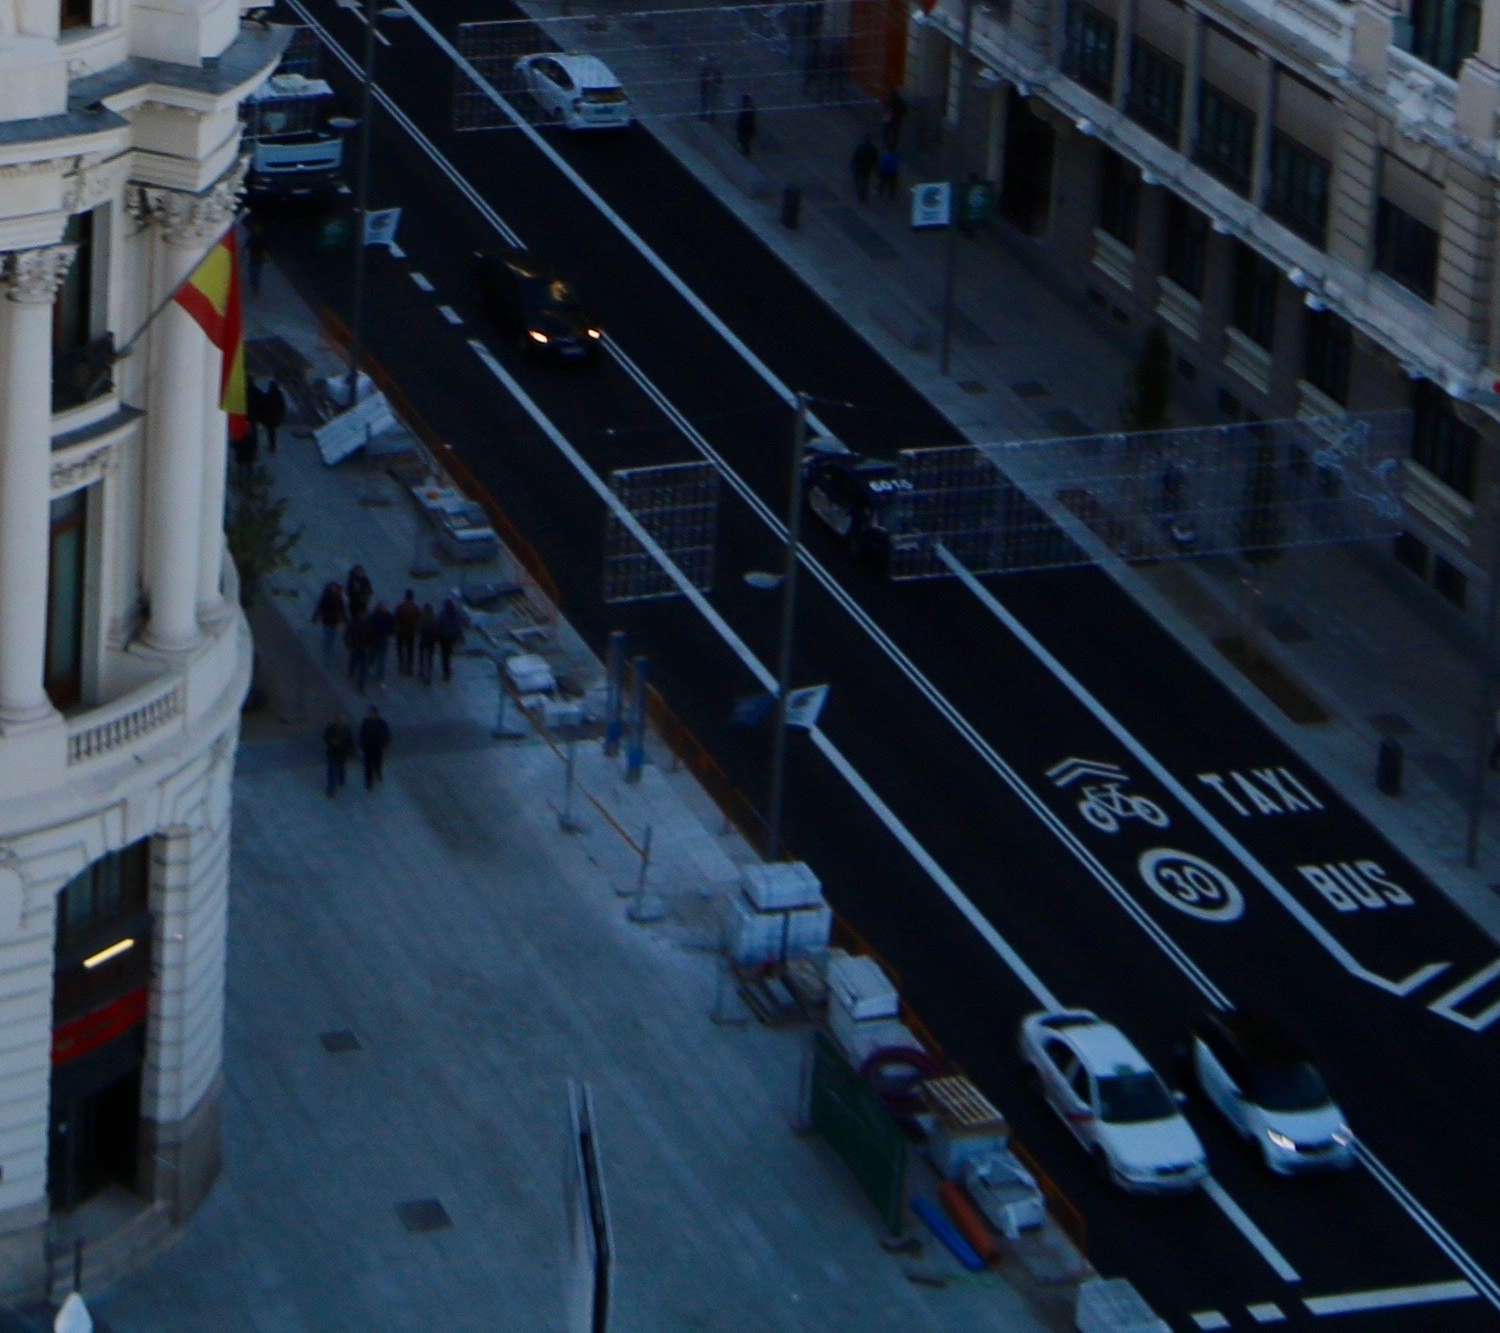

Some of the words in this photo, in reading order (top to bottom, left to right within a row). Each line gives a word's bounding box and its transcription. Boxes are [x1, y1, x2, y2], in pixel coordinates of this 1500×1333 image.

[1197, 766, 1325, 817] TAXI
[1159, 865, 1220, 903] 30
[1296, 859, 1415, 912] BUS
